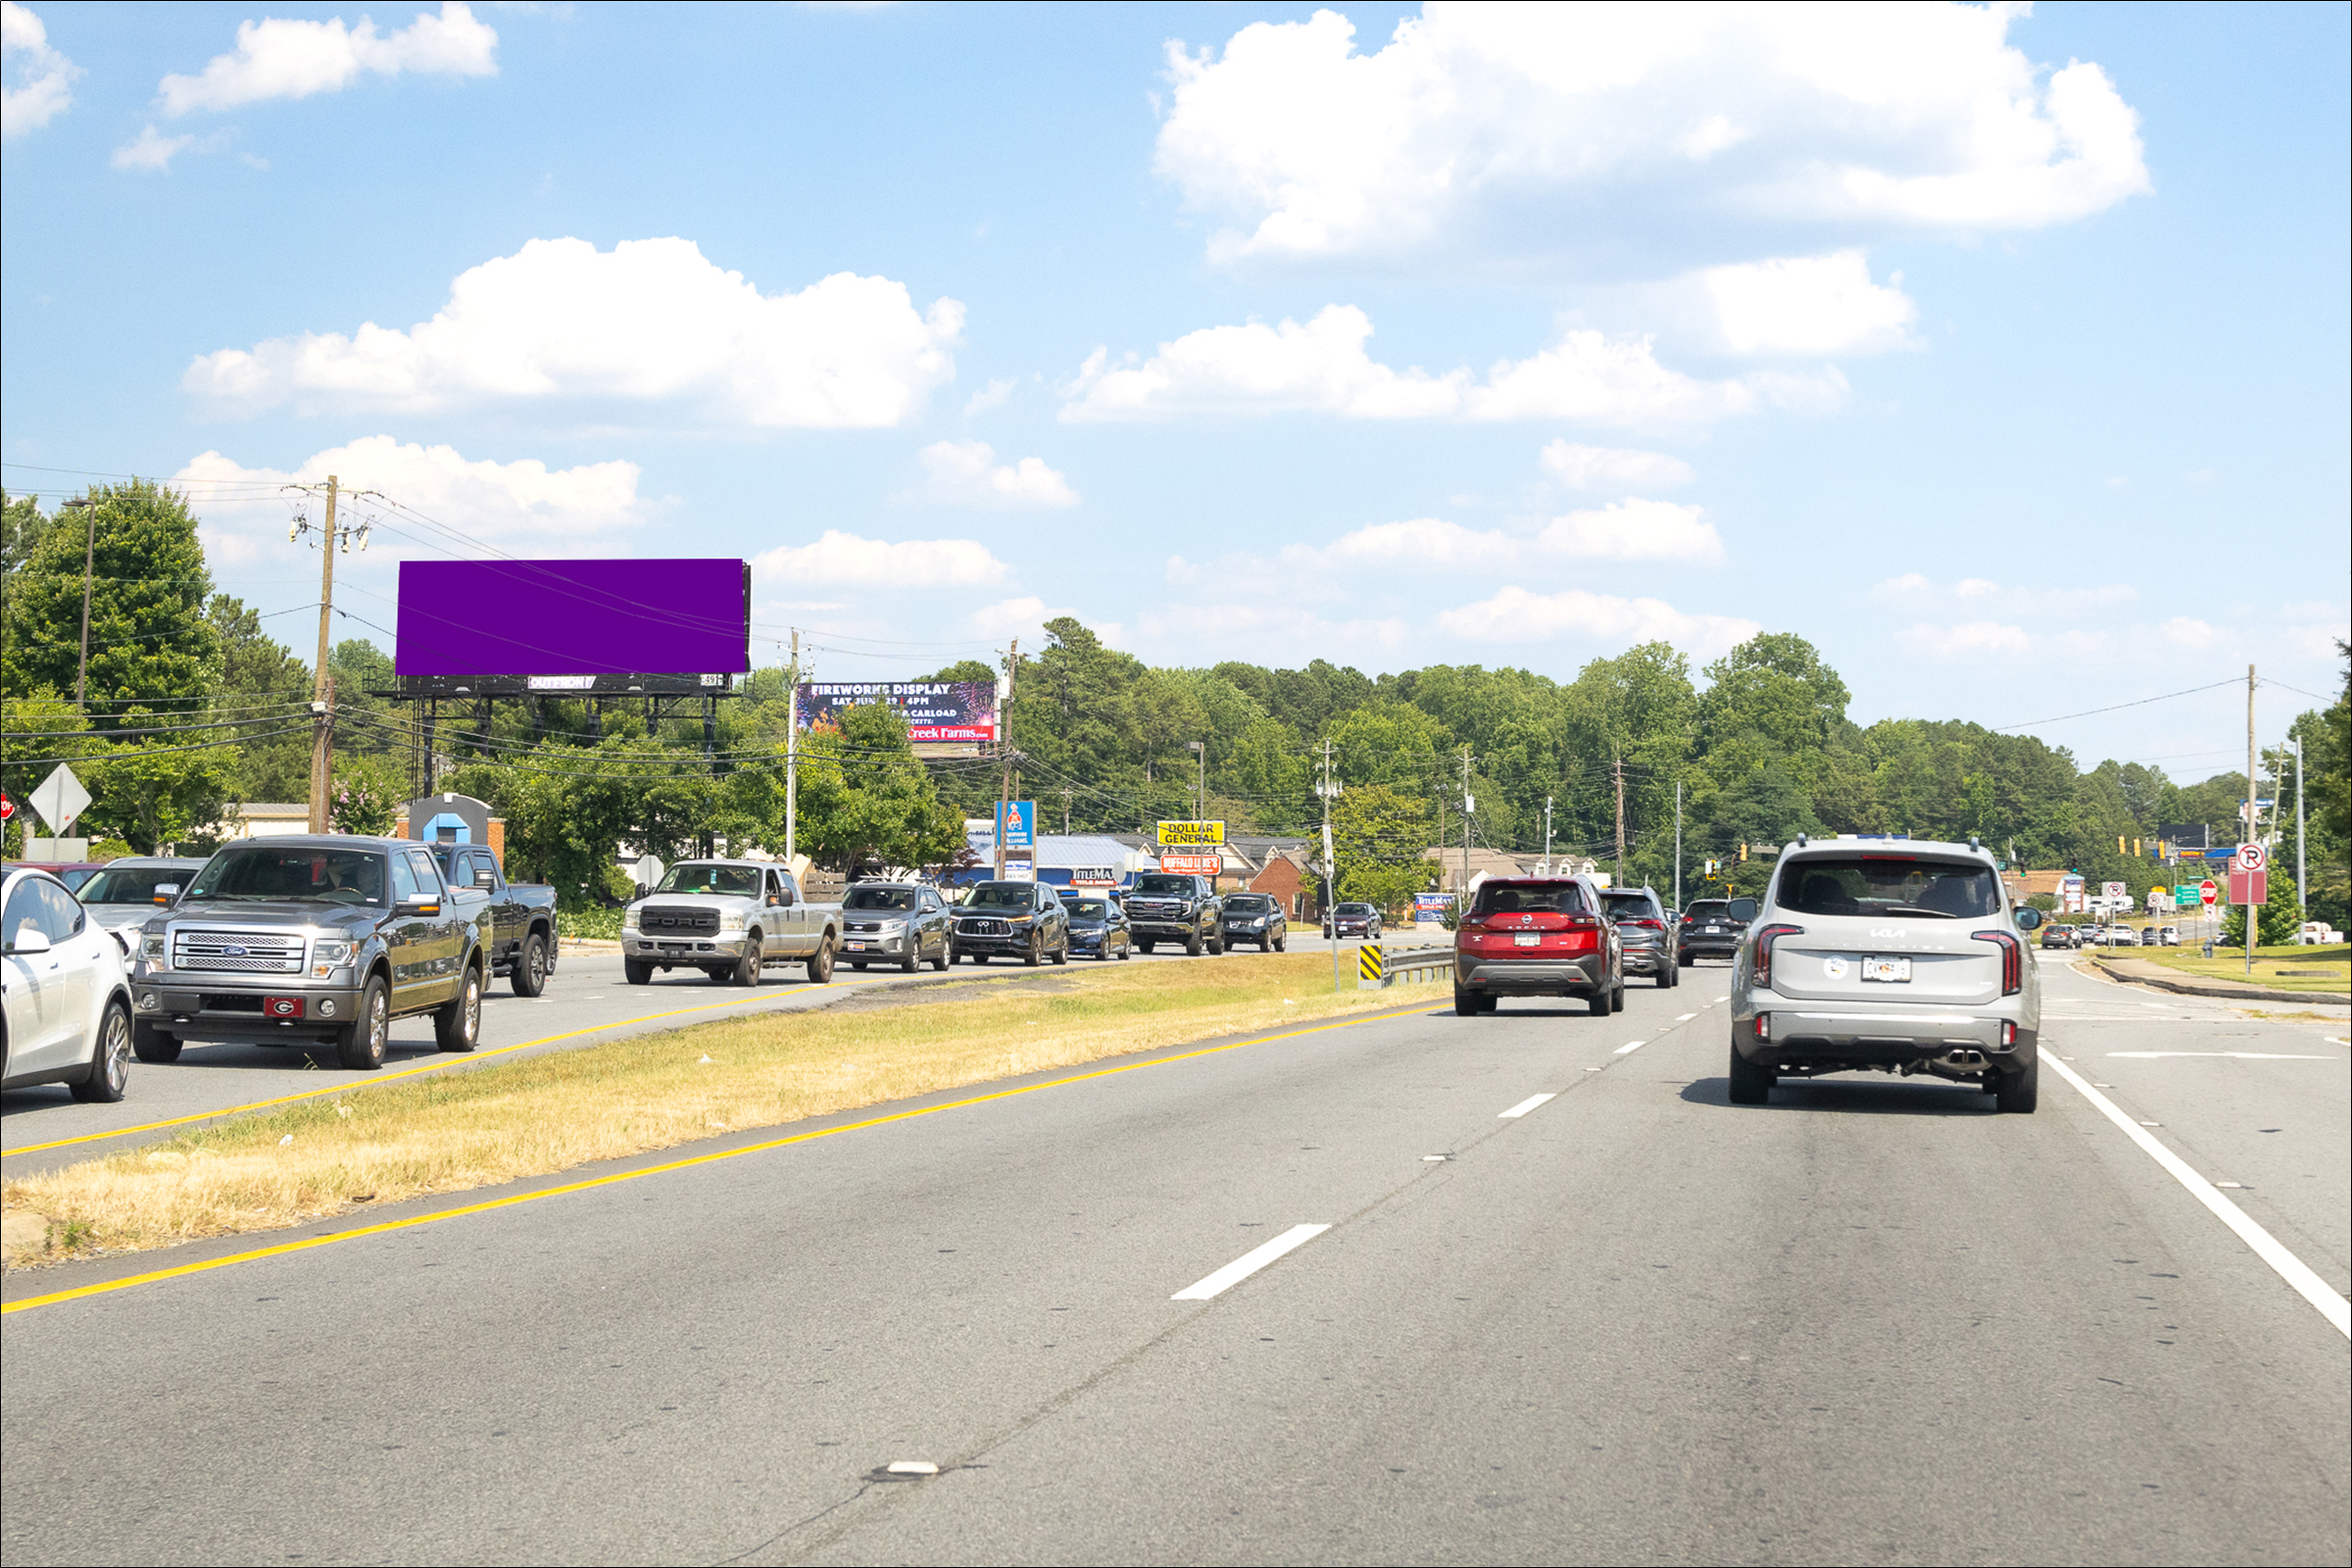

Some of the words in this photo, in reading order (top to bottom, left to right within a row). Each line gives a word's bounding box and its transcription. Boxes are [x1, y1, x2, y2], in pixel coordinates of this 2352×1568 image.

[811, 684, 891, 696] FIREWORKS
[893, 684, 952, 696] DISPLAY
[832, 697, 853, 706] SAT
[855, 697, 879, 706] JUN
[906, 697, 929, 706] 4PM
[910, 709, 957, 717] CARLOAD
[1168, 824, 1214, 833] DOLLAR
[1165, 834, 1217, 844] GENERAL
[1163, 857, 1194, 868] BUFFALO
[645, 917, 710, 926] FORD
[1870, 928, 1907, 938] KIA
[1830, 942, 1945, 951] TELLURIDE
[226, 947, 244, 956] Ford
